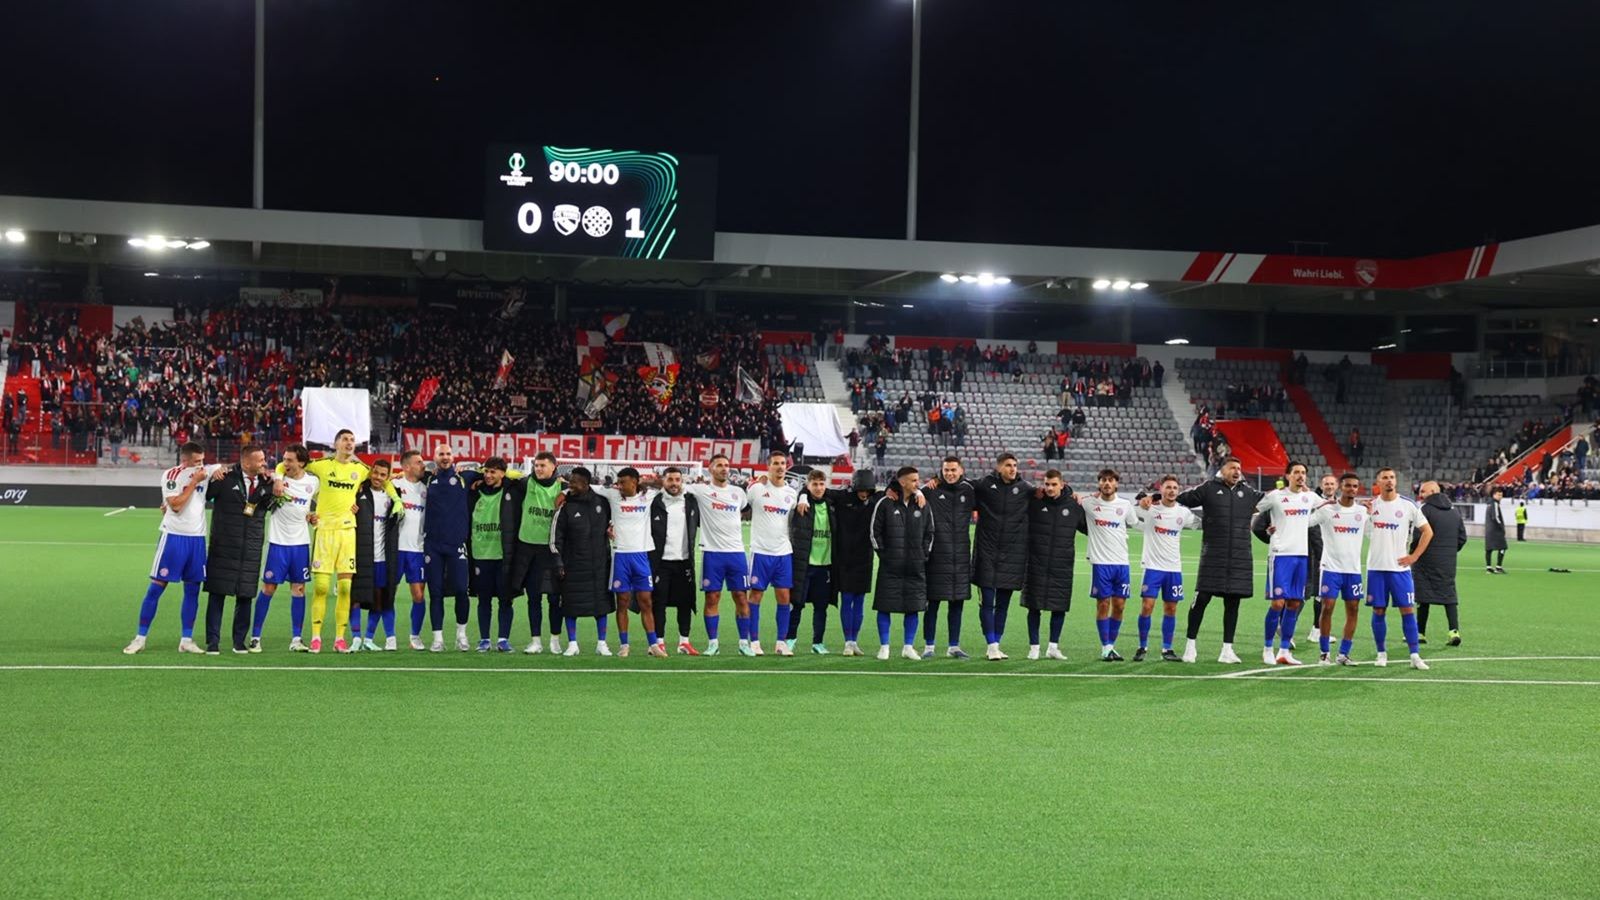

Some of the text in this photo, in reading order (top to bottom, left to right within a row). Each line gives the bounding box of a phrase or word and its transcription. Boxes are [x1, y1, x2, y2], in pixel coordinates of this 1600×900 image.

[549, 160, 619, 185] 90:00
[517, 202, 542, 234] 0
[625, 207, 645, 238] 1
[1293, 268, 1319, 278] Wahri
[328, 480, 354, 490] TOMMY
[403, 502, 424, 512] OMMY
[712, 502, 737, 512] TOMMY
[763, 505, 788, 515] TOMMY
[1095, 519, 1119, 528] TOMMY
[1373, 522, 1398, 530] TOMMY
[1154, 526, 1179, 536] TOMMY
[1334, 526, 1359, 534] TOMMY
[302, 567, 310, 580] 2
[1172, 584, 1184, 597] 32
